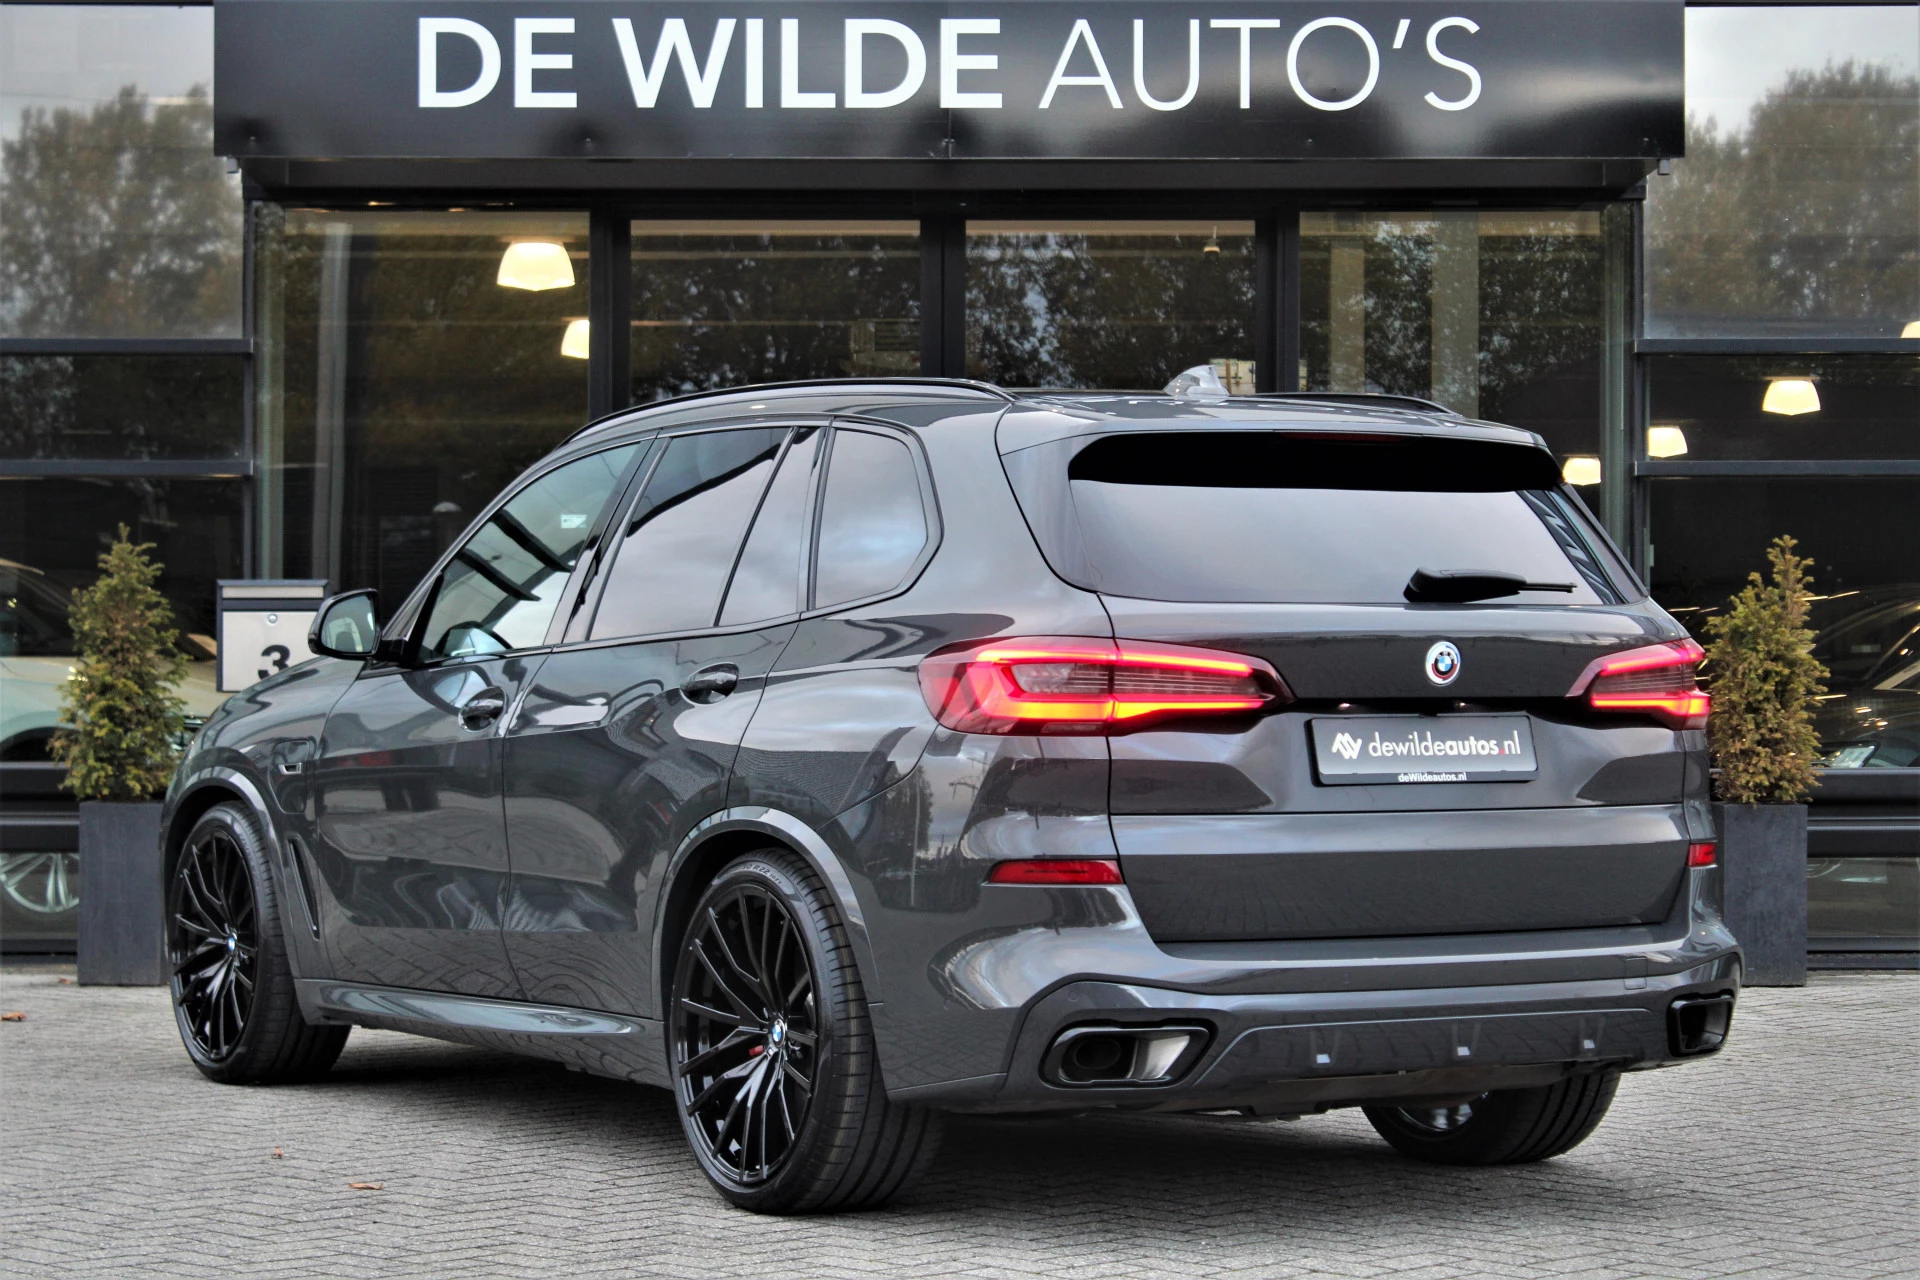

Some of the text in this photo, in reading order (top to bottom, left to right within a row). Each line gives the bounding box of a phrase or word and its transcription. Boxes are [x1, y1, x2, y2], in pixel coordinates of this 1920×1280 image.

[418, 17, 578, 109] DE
[611, 17, 1003, 109] WILDE
[257, 644, 291, 680] 3
[1368, 730, 1521, 757] dewildeautos.nl
[1398, 772, 1468, 782] deWildeautos.nl
